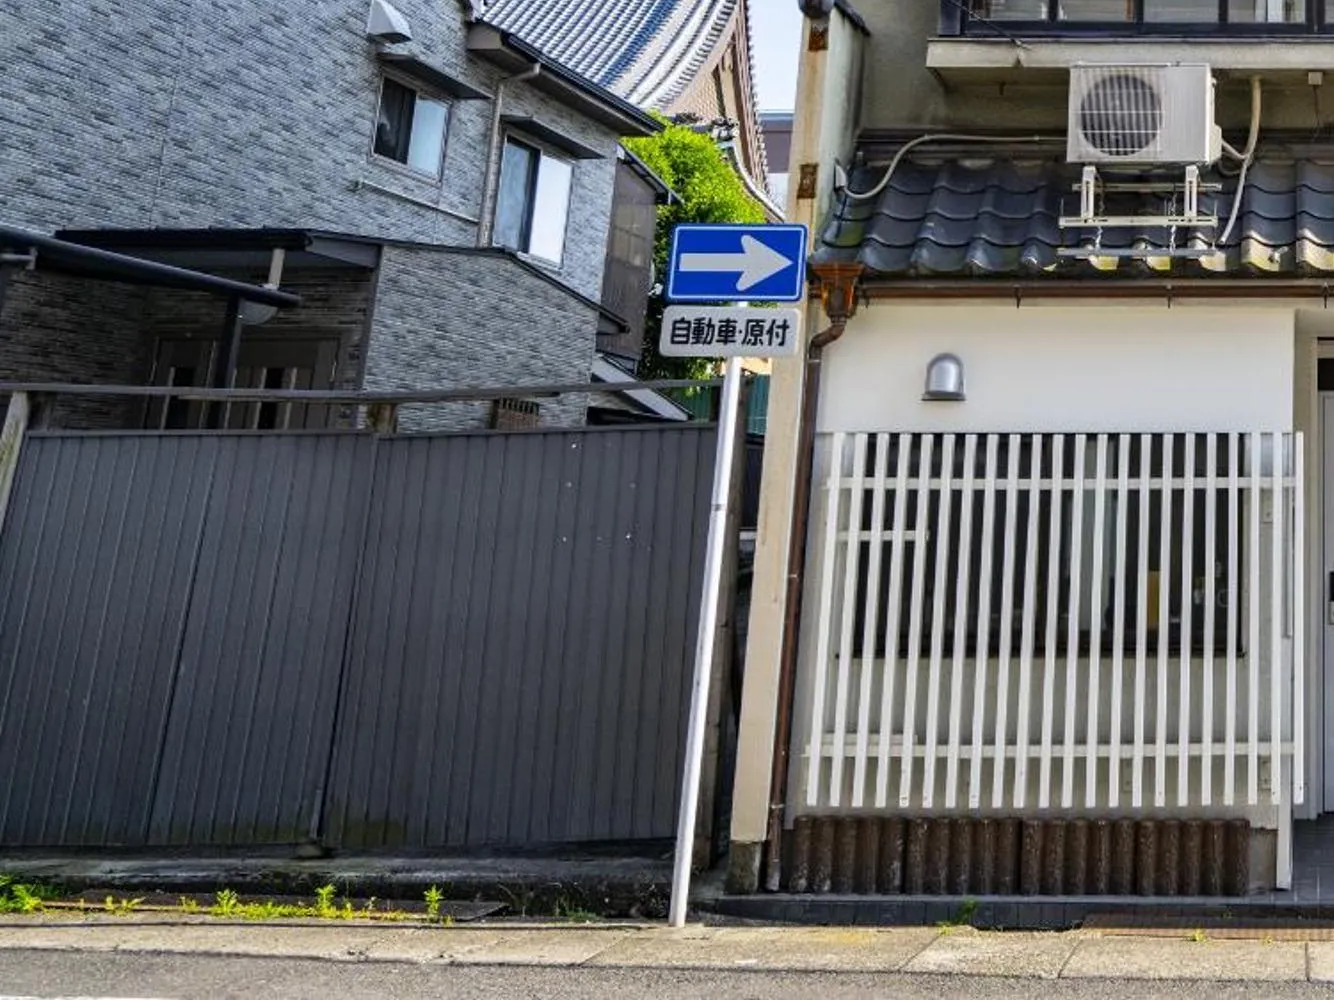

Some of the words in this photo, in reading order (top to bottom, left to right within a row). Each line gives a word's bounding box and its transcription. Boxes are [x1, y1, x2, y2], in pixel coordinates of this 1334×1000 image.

[670, 317, 790, 346] 自動車・原付
